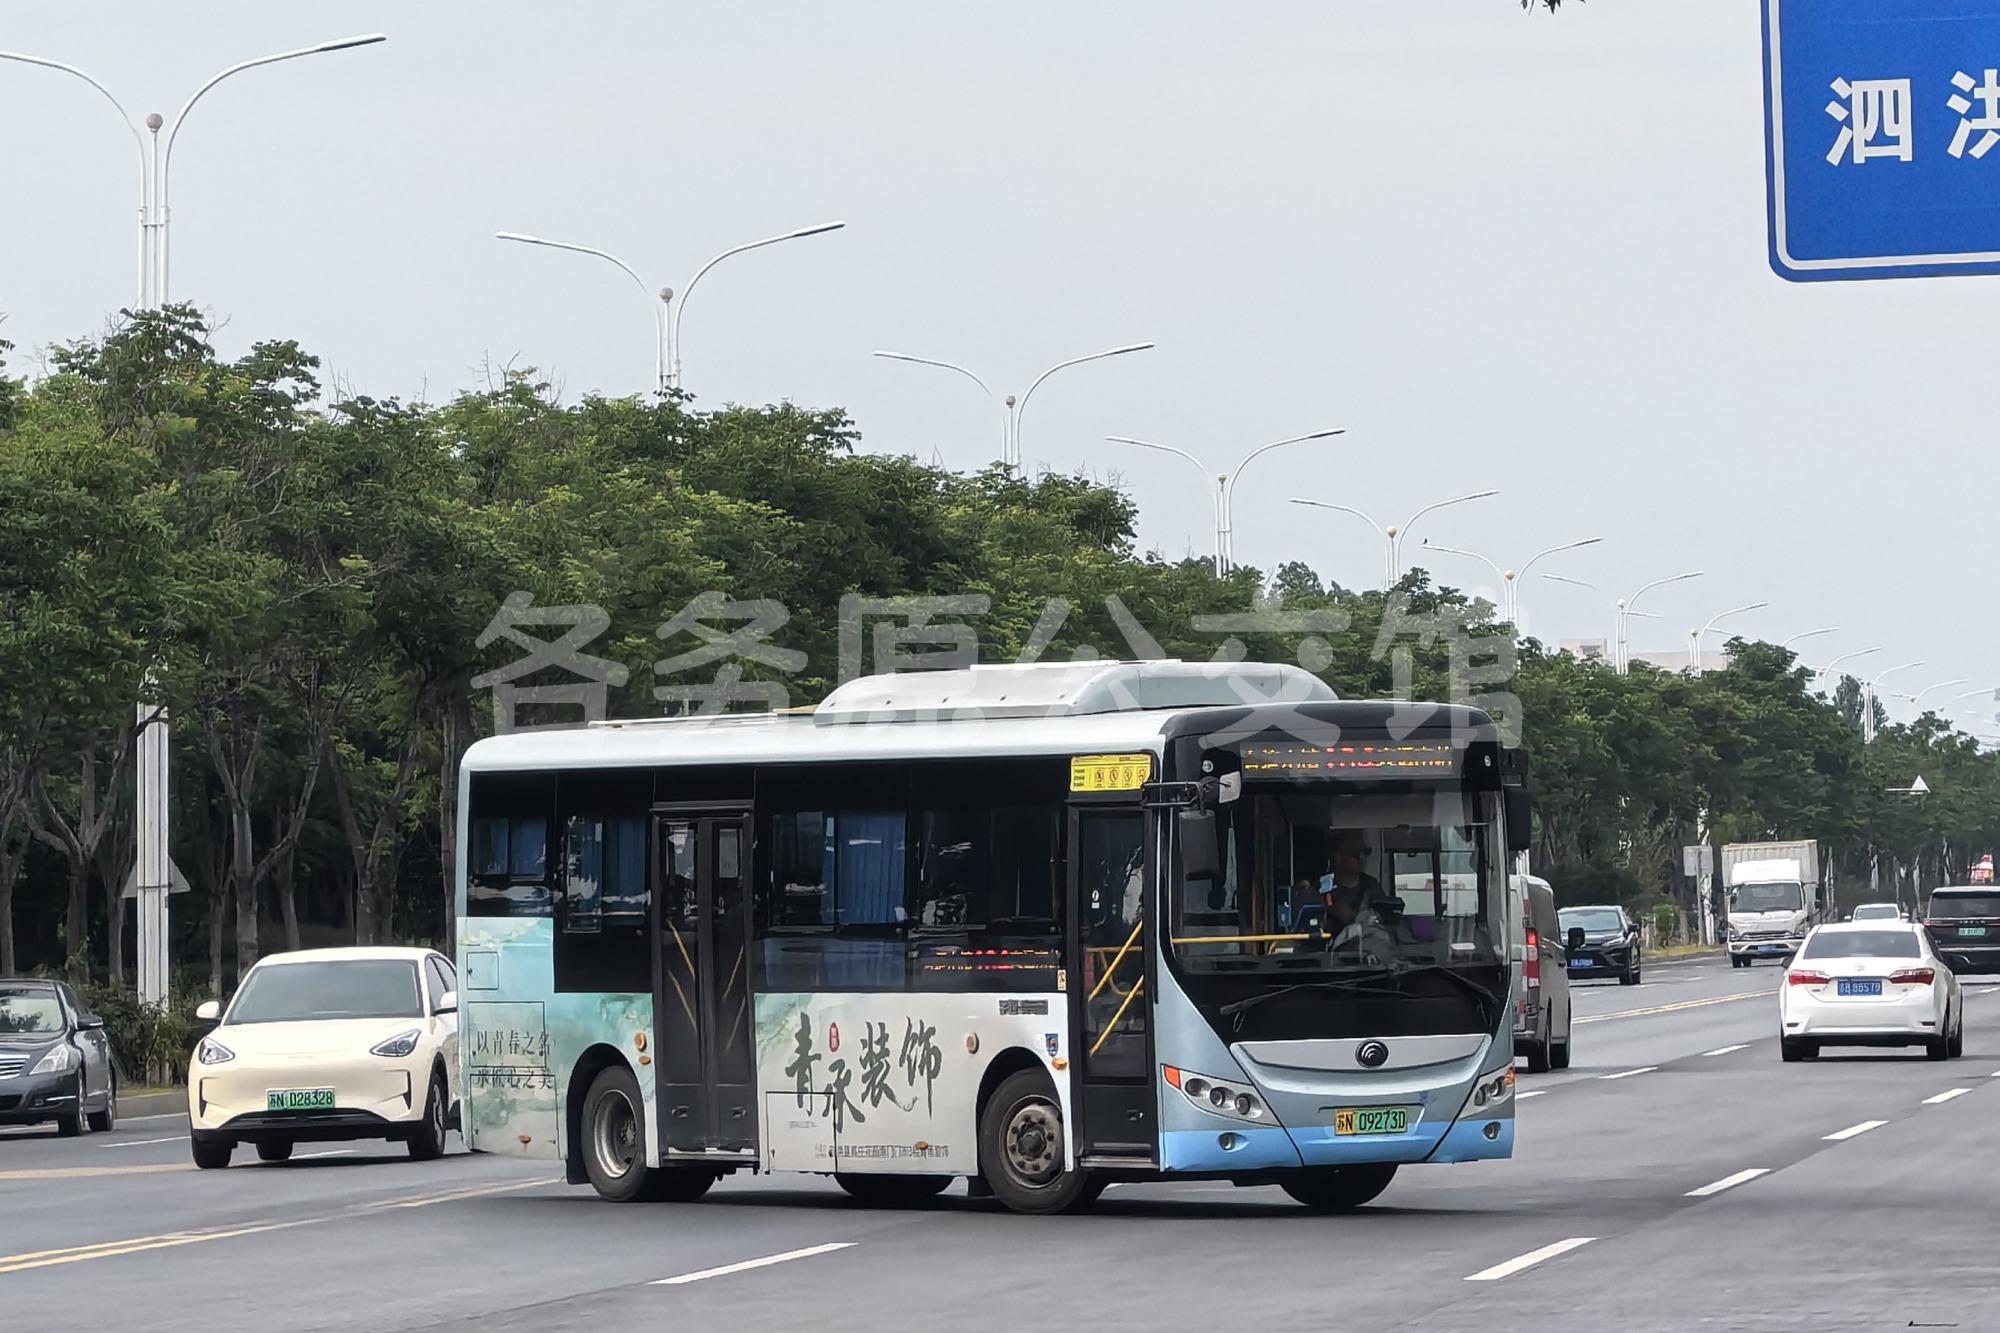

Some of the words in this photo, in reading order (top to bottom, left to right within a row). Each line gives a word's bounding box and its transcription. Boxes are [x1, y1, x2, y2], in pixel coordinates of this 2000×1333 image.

[477, 1029, 551, 1056] 以青春之名
[289, 1090, 333, 1107] D28328
[1359, 1110, 1406, 1130] 09273D
